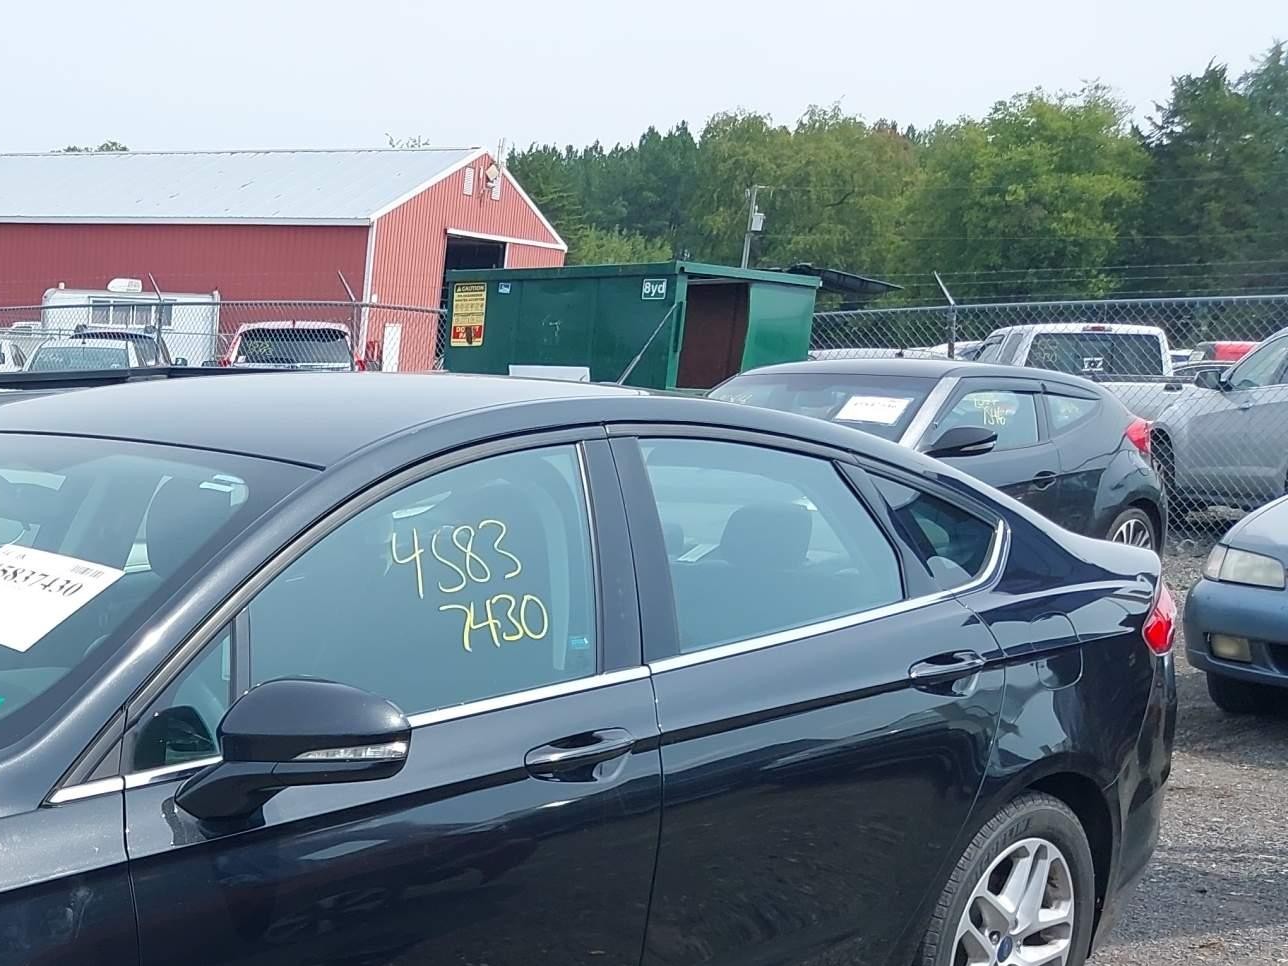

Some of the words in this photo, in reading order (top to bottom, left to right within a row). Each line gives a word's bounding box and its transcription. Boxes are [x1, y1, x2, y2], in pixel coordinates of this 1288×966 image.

[644, 281, 665, 297] 8yd
[391, 519, 522, 600] 4583
[438, 594, 548, 653] 7430
